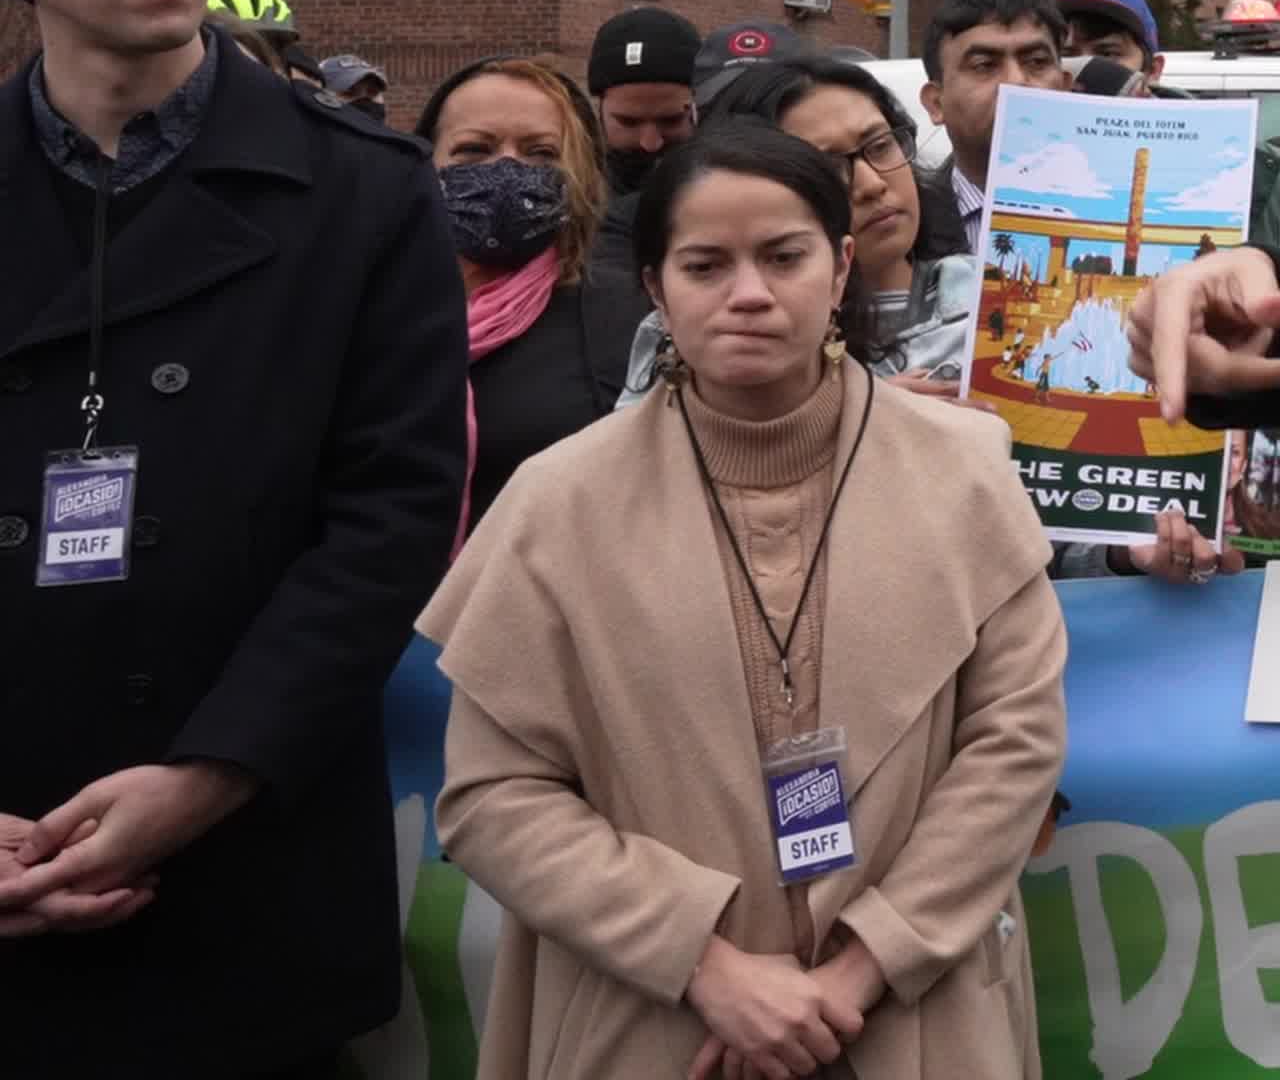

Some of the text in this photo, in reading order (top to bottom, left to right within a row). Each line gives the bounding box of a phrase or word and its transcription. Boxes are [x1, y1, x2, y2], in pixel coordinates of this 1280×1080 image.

[1012, 460, 1206, 492] HE GREEN
[1107, 493, 1207, 519] DEAL
[59, 535, 111, 556] STAFF
[791, 831, 840, 860] STAFF
